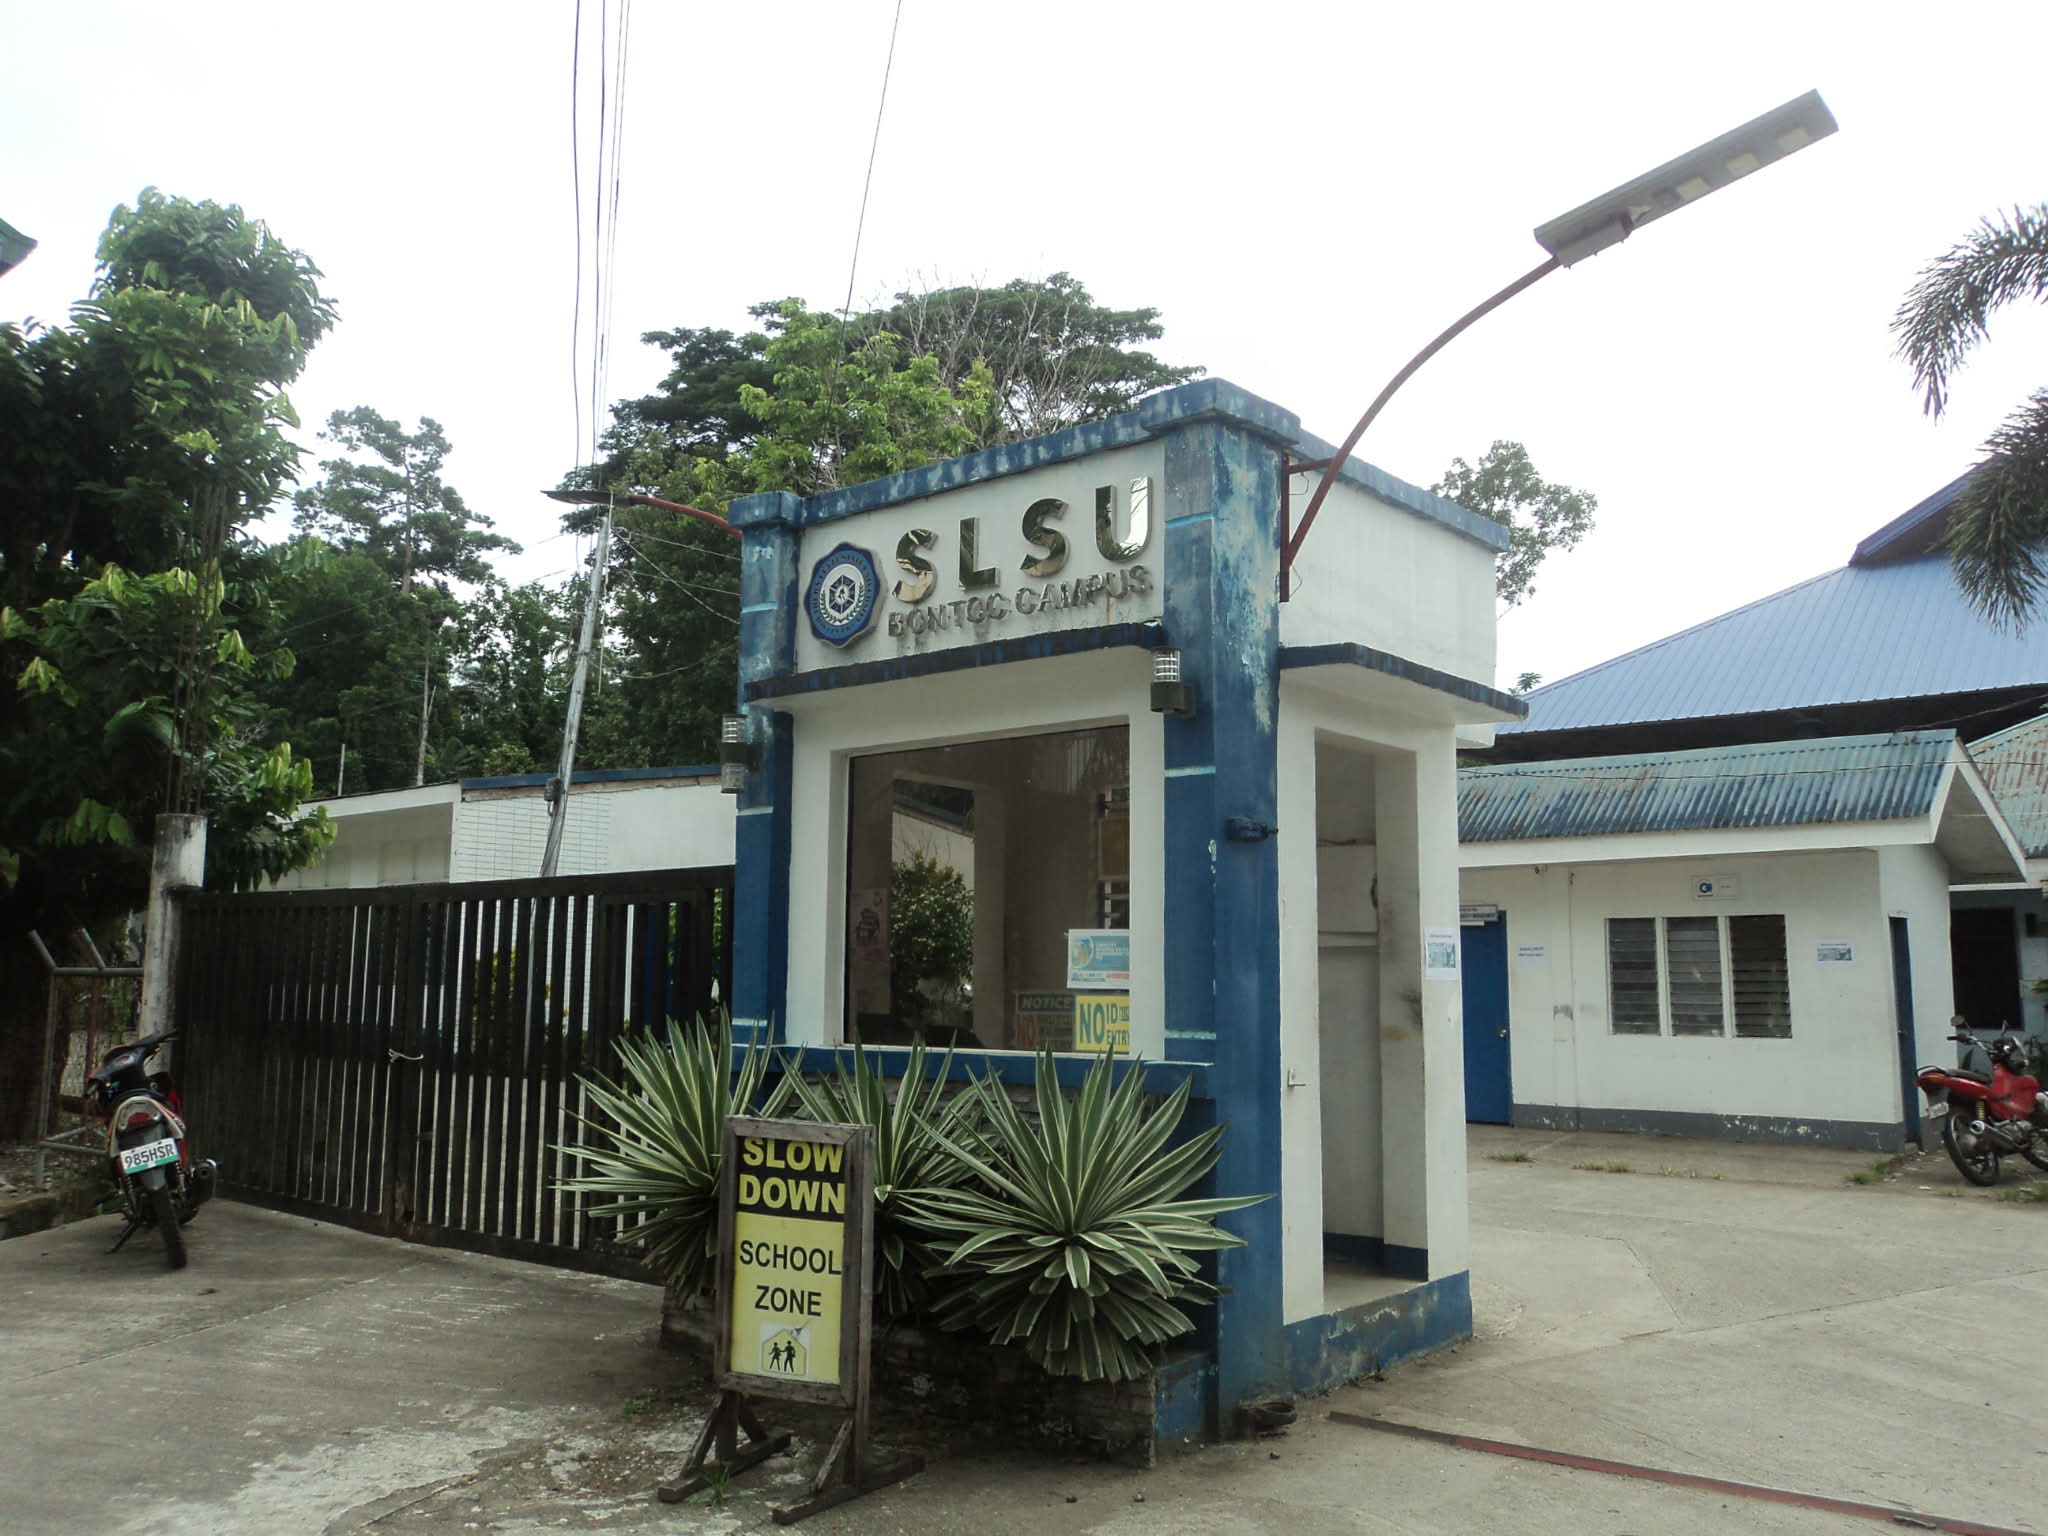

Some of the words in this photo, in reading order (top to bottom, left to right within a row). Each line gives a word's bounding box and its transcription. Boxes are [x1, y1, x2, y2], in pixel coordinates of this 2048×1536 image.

[891, 475, 1152, 603] SLSU
[888, 592, 1011, 637] BONTOC
[1015, 565, 1153, 615] CAMPUS
[1079, 1002, 1105, 1045] NO
[125, 1144, 174, 1168] 985HSR
[742, 1137, 844, 1173] SLOW
[738, 1174, 845, 1214] DOWN
[739, 1239, 842, 1276] SCHOOL
[754, 1284, 822, 1317] ZONE
